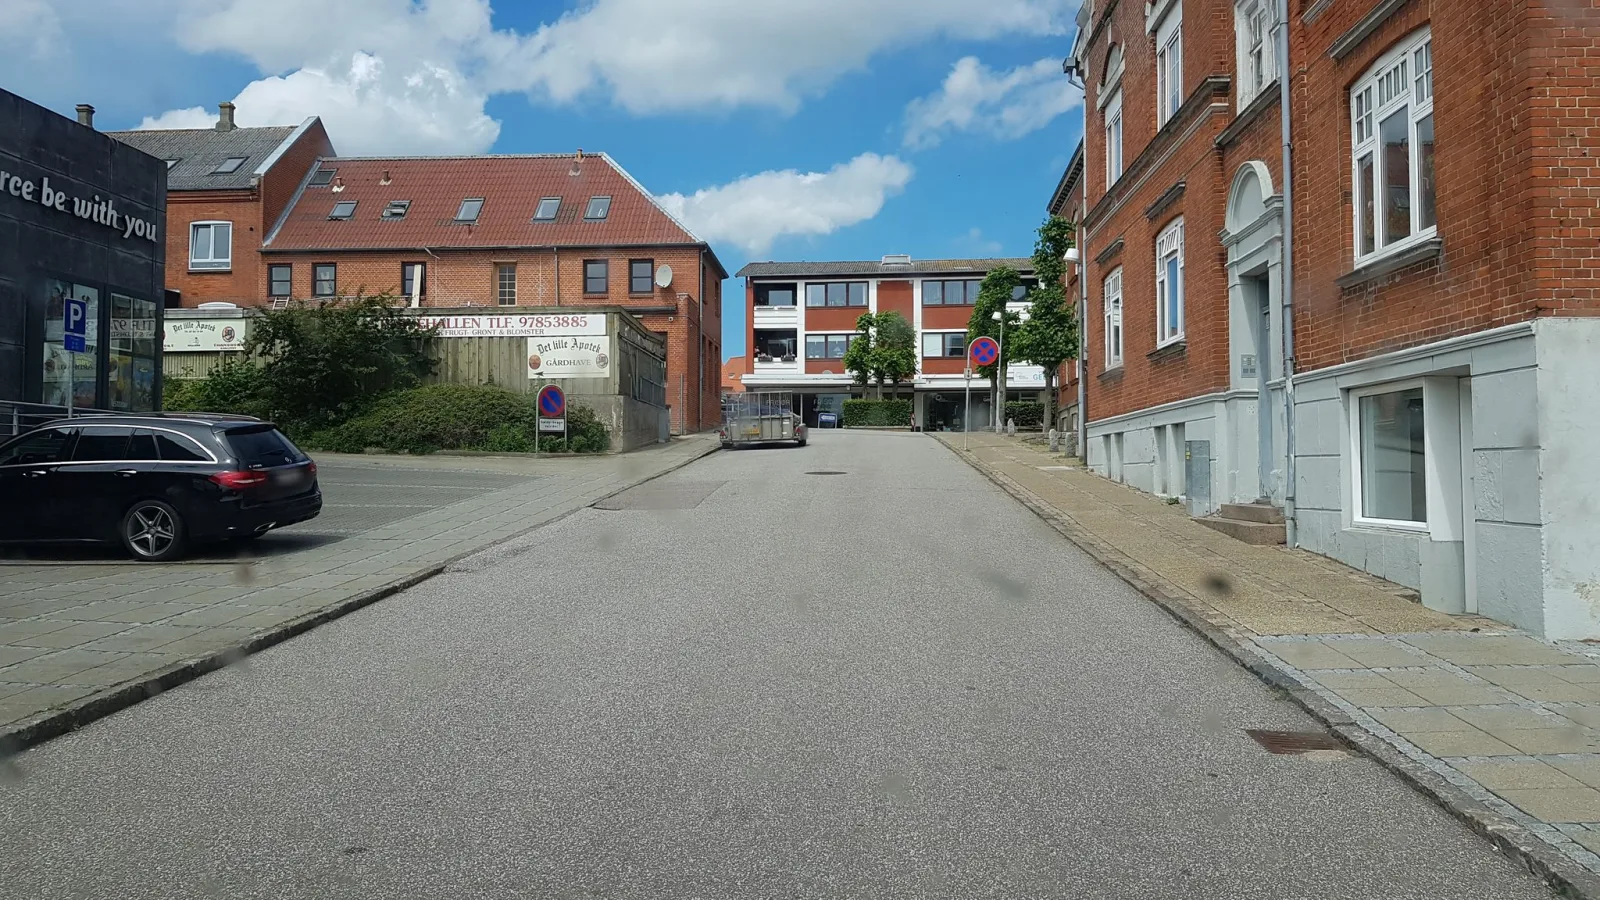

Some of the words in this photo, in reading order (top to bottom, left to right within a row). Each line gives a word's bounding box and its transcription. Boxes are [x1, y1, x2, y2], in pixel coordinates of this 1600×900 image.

[41, 177, 66, 211] be
[73, 195, 118, 229] with
[123, 214, 157, 242] you
[69, 303, 83, 330] P
[487, 317, 514, 329] TLF.
[519, 316, 588, 328] 97853885
[195, 320, 216, 332] Apotek
[536, 343, 552, 356] Det
[552, 339, 568, 350] lille
[570, 337, 601, 354] Apotek
[545, 358, 592, 367] GÅRDHAVE
